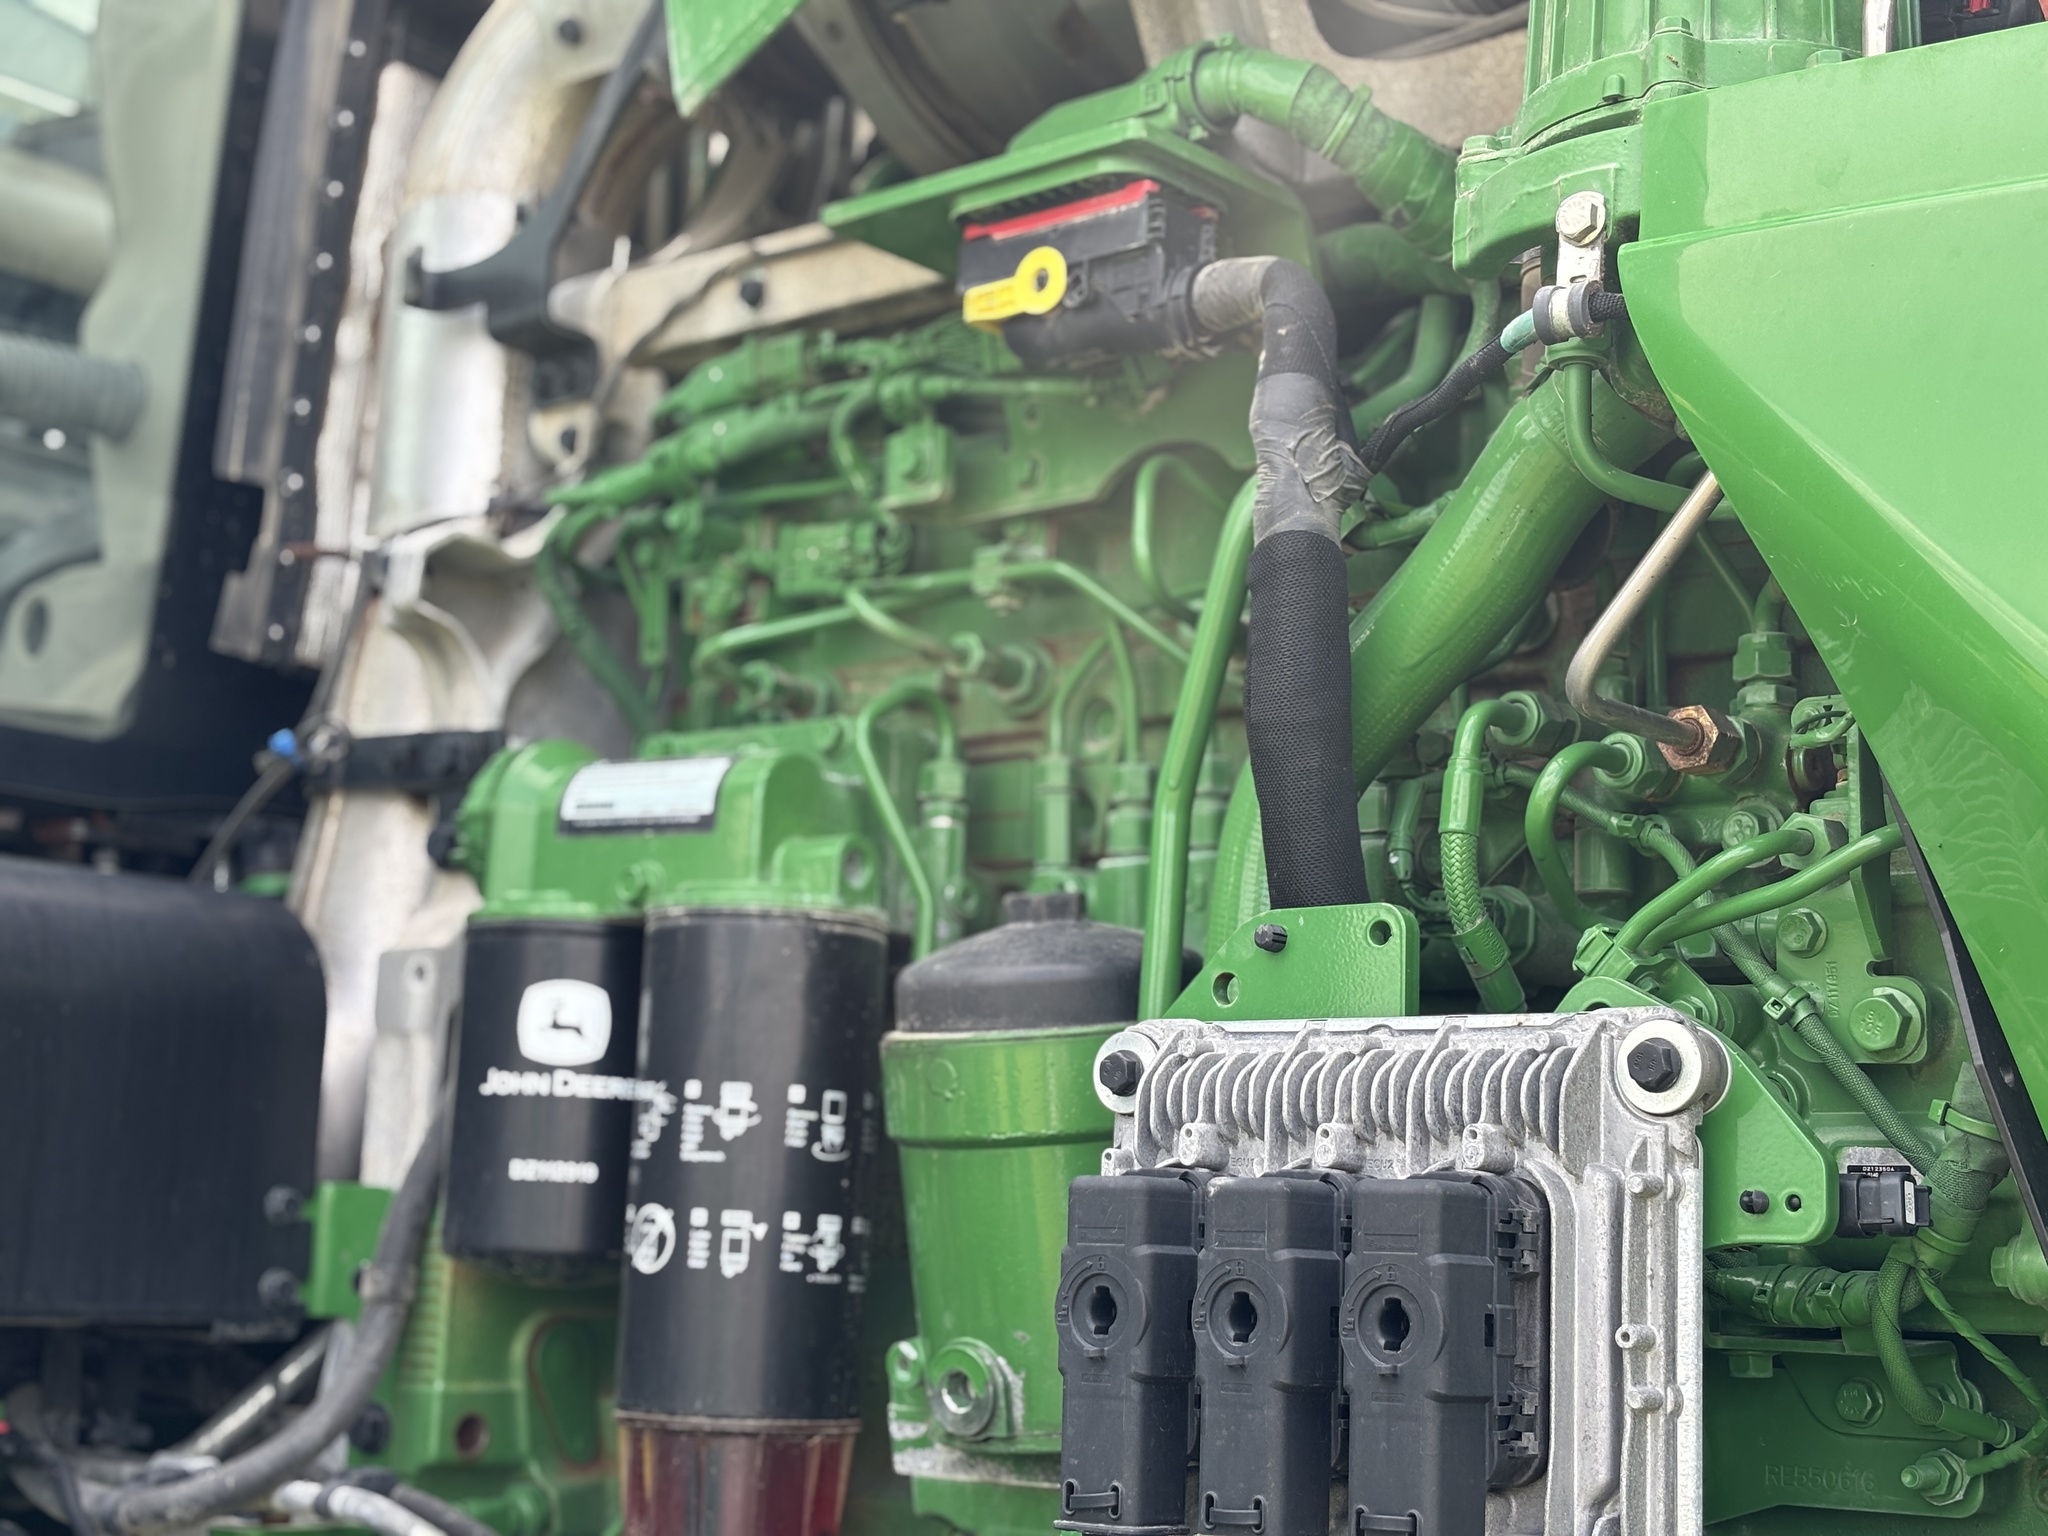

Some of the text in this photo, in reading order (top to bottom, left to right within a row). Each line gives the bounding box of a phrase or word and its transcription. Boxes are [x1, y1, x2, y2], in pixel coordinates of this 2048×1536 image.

[478, 1067, 638, 1100] JOHN DEERE
[1230, 1157, 1254, 1167] ECU1
[1366, 1158, 1394, 1169] ECU2
[1764, 1462, 1876, 1494] RE550616
